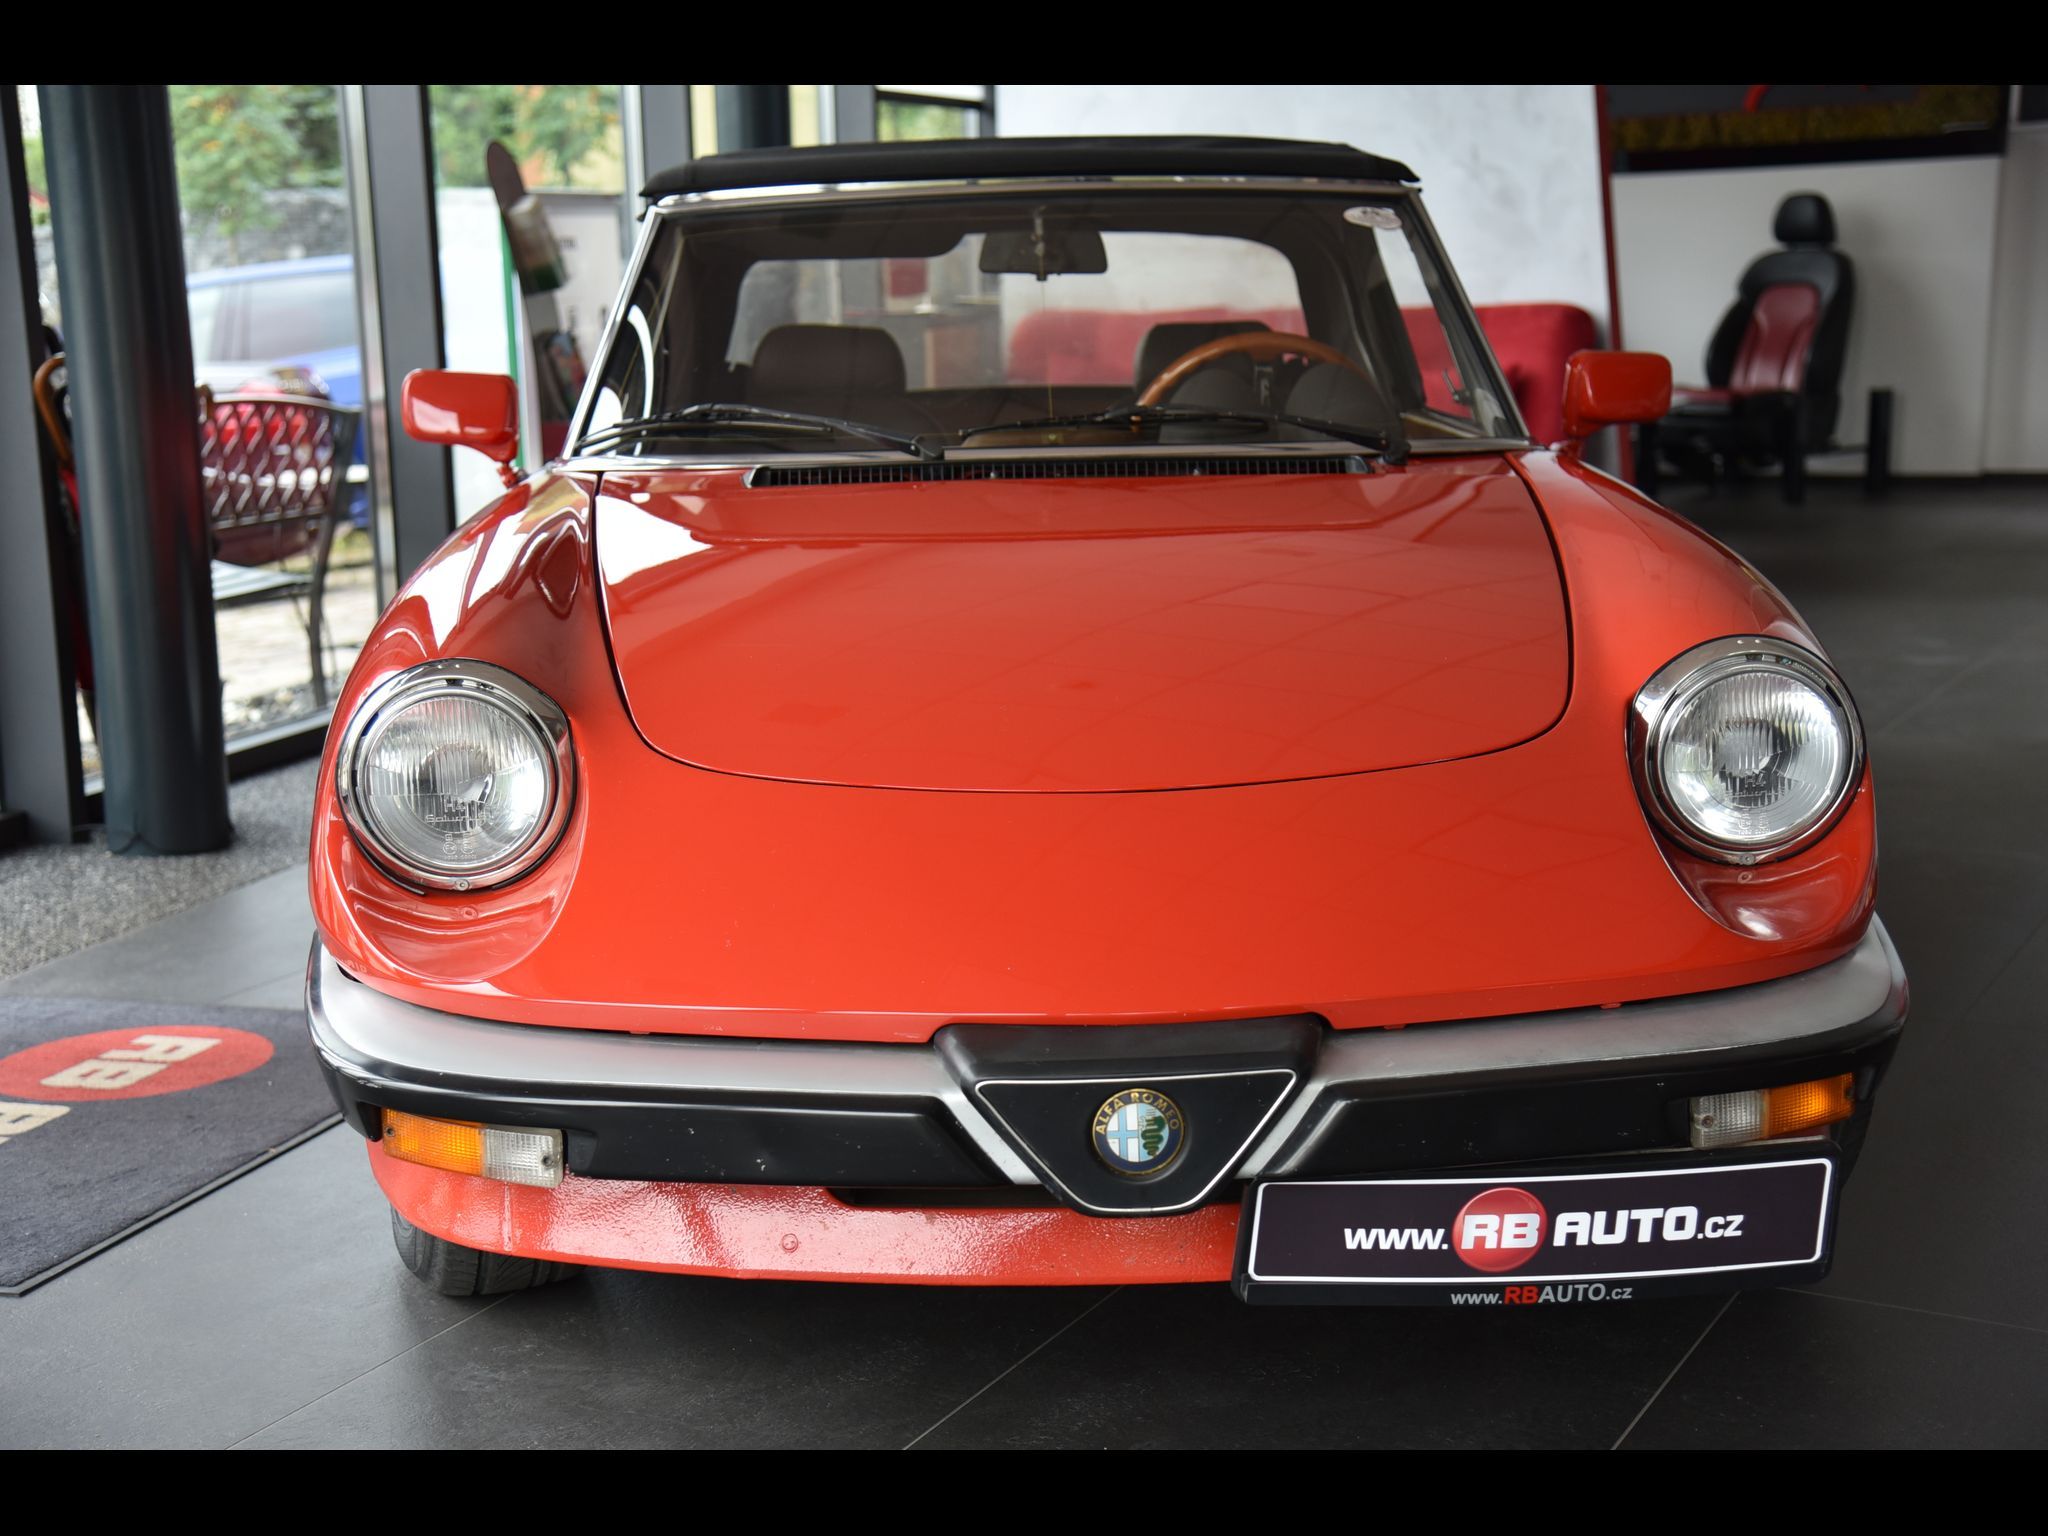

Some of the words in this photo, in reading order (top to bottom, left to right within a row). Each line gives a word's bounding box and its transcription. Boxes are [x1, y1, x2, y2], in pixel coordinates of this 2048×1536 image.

[1095, 1098, 1124, 1135] ALFA
[1130, 1092, 1180, 1130] ROMEO
[1343, 1227, 1449, 1250] www.
[1460, 1213, 1540, 1250] RB
[1552, 1205, 1744, 1247] AUTO.cz
[1451, 1283, 1633, 1306] www.RBAUTO.cz
